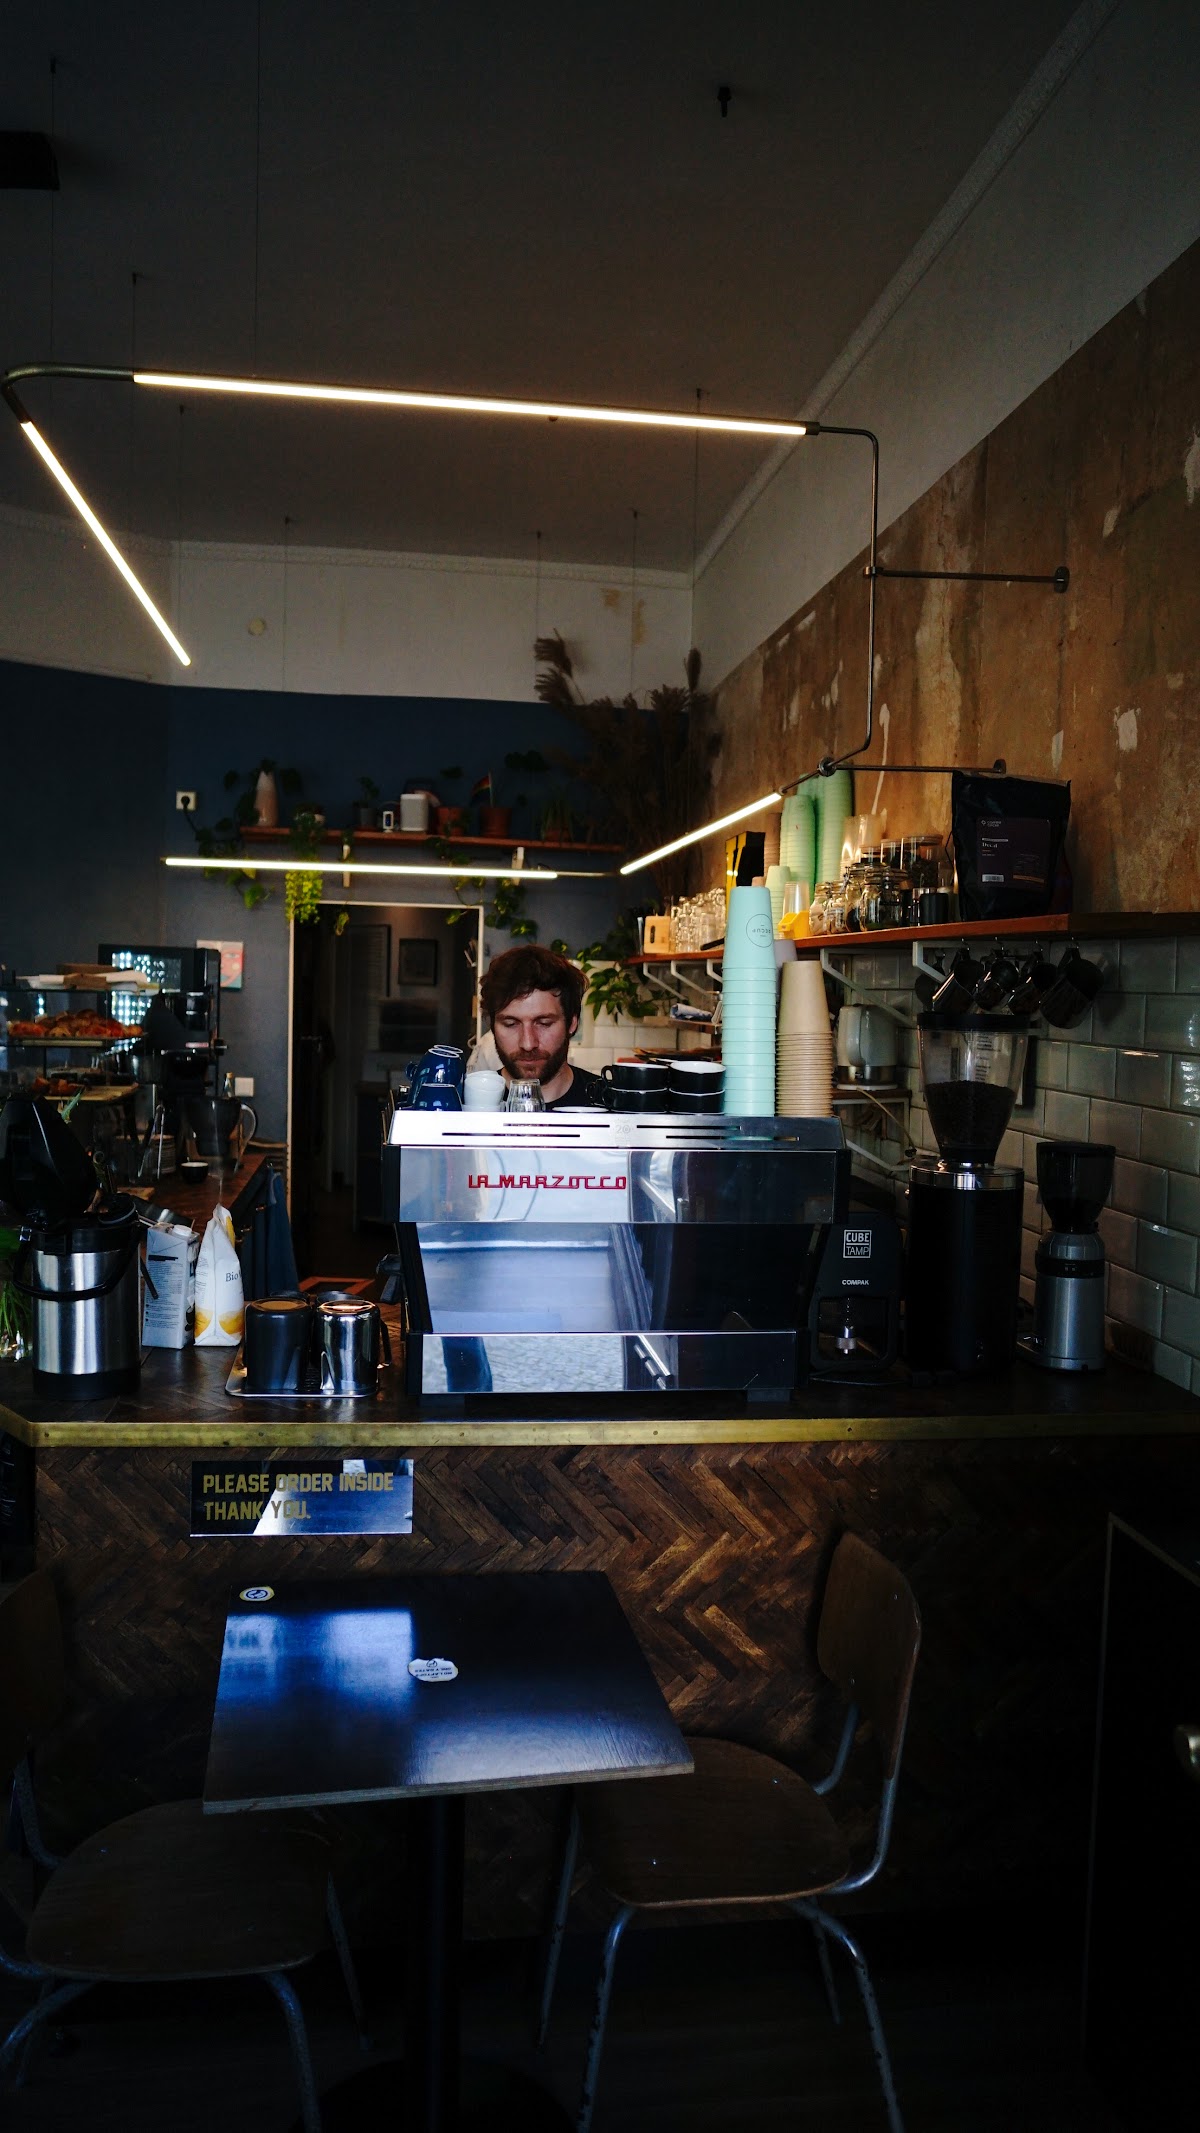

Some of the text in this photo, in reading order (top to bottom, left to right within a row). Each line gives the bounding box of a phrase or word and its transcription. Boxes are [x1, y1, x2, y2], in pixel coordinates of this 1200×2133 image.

[468, 1175, 489, 1188] LA
[846, 1232, 870, 1242] CUBE
[846, 1246, 870, 1255] TAMP
[202, 1471, 394, 1493] PLEASE ORDER INSIDE
[204, 1500, 311, 1520] THANK YOU.
